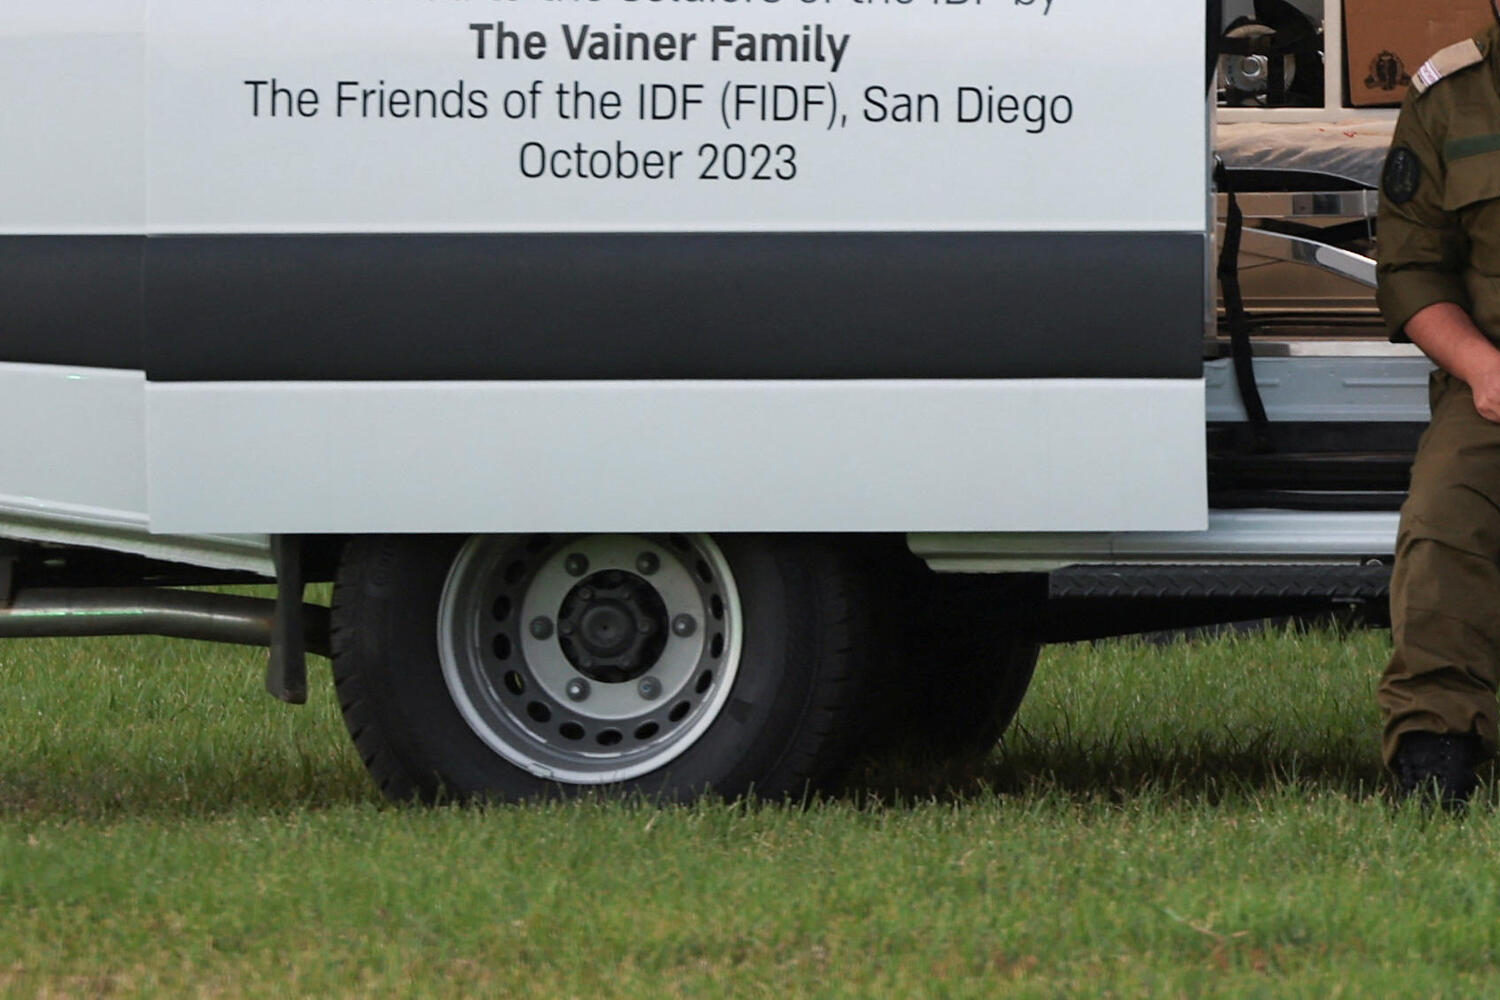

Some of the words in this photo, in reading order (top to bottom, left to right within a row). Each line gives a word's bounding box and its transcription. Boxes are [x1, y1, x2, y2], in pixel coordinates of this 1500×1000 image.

[469, 21, 548, 61] The
[561, 23, 697, 62] Vainer
[712, 24, 851, 73] Family
[244, 78, 320, 118] The
[337, 79, 489, 120] Friends
[503, 80, 543, 120] of
[555, 81, 623, 121] the
[639, 83, 705, 121] IDF
[721, 81, 847, 131] (FIDF),
[863, 85, 939, 123] San
[958, 84, 1074, 135] Diego
[520, 140, 684, 180] October
[698, 143, 798, 181] 2023
